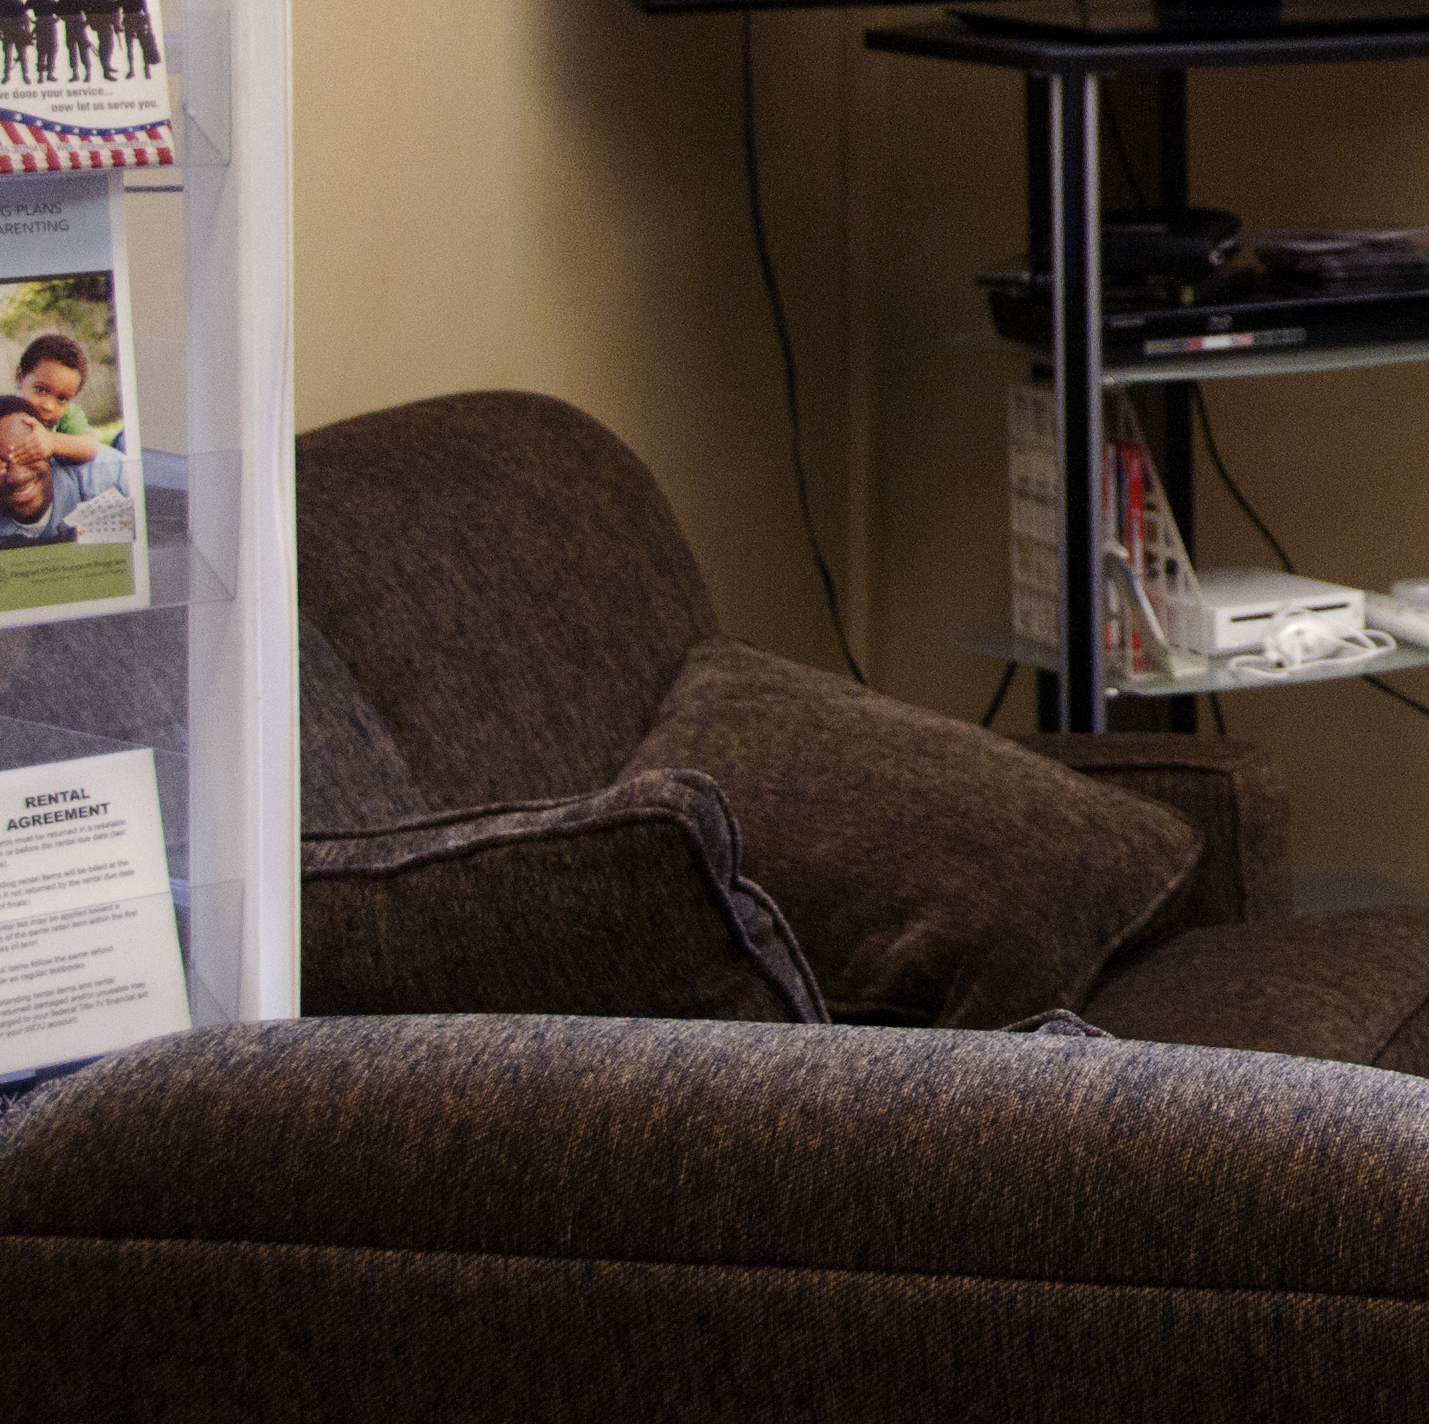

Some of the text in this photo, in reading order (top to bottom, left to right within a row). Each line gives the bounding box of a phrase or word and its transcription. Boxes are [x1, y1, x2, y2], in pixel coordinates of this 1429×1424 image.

[16, 201, 62, 216] PLANS
[0, 219, 69, 234] ARENTING
[25, 787, 91, 809] RENTAL
[7, 802, 111, 831] AGREEMENT
